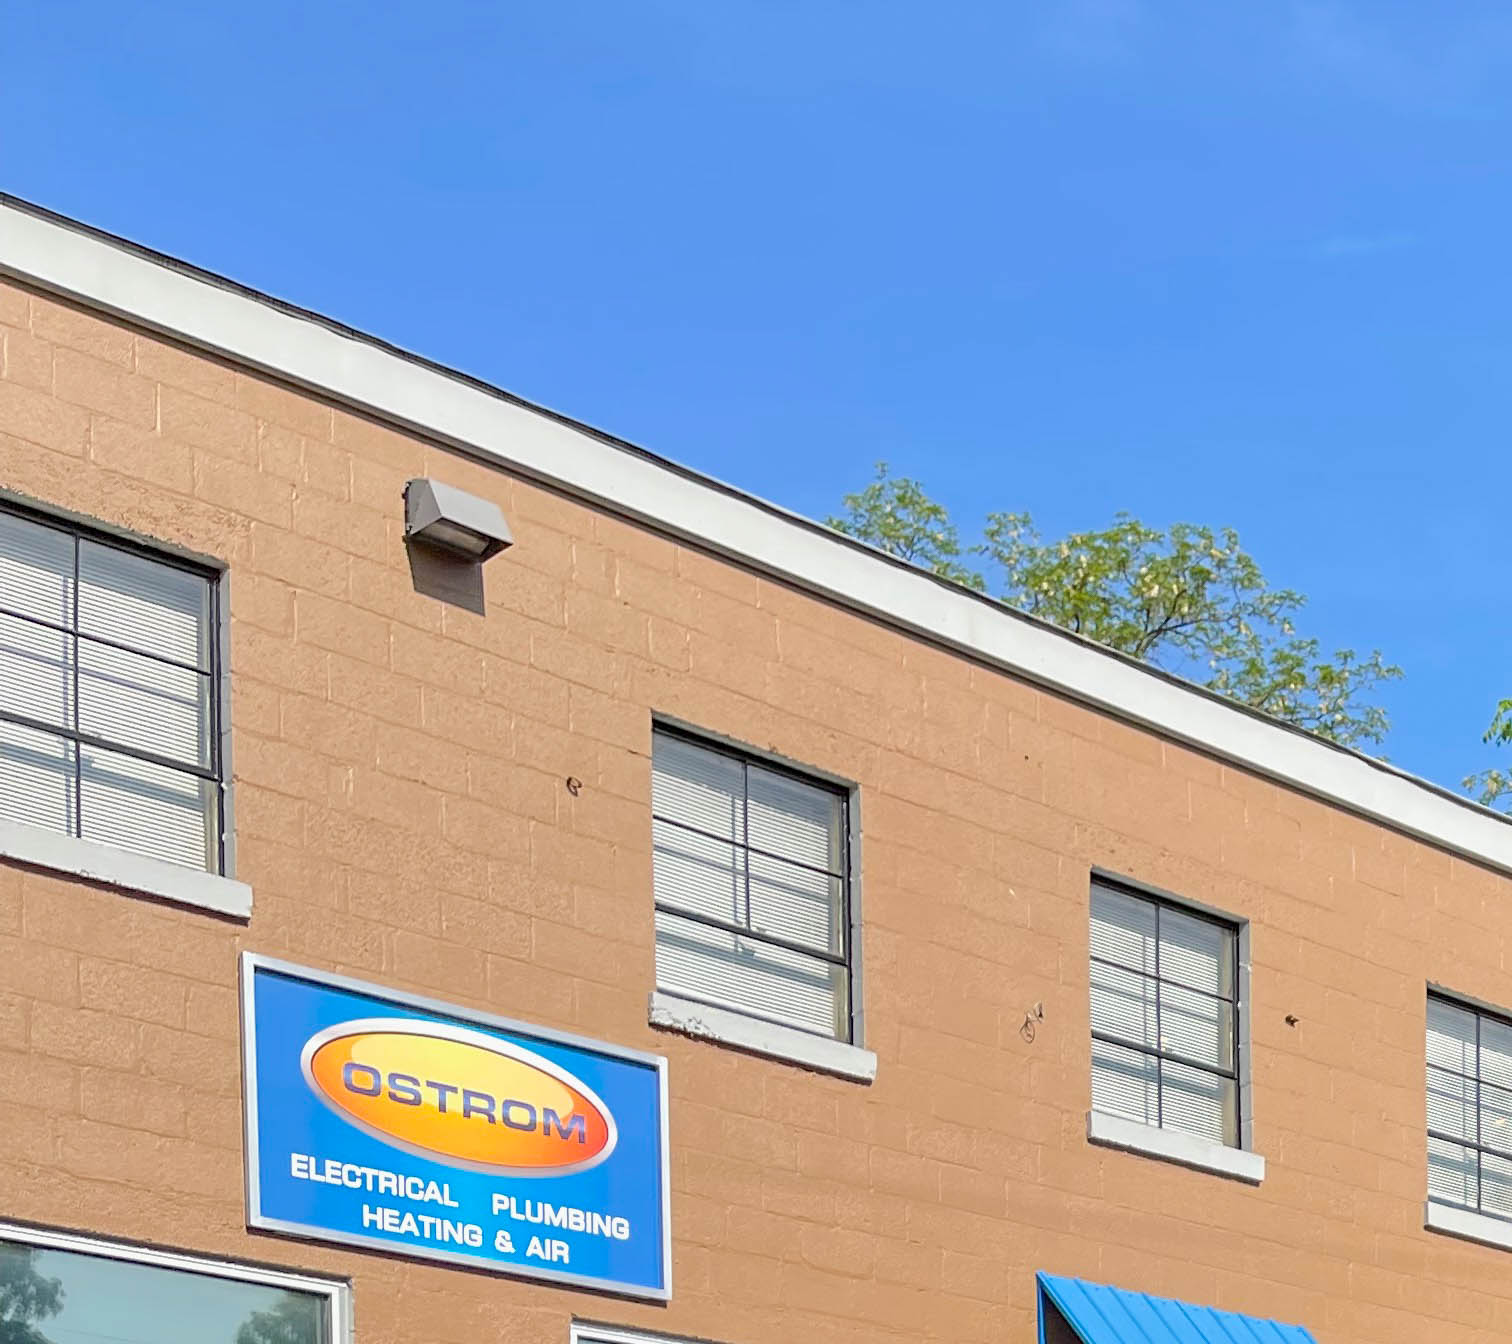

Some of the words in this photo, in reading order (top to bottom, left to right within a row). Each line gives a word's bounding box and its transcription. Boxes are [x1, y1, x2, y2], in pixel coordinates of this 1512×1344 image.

[343, 1061, 586, 1145] OSTROM
[290, 1153, 459, 1208] ELECTRICAL
[492, 1193, 630, 1241] PLUMBING
[362, 1205, 483, 1247] HEATING
[494, 1231, 516, 1253] &
[525, 1235, 570, 1264] AIR
